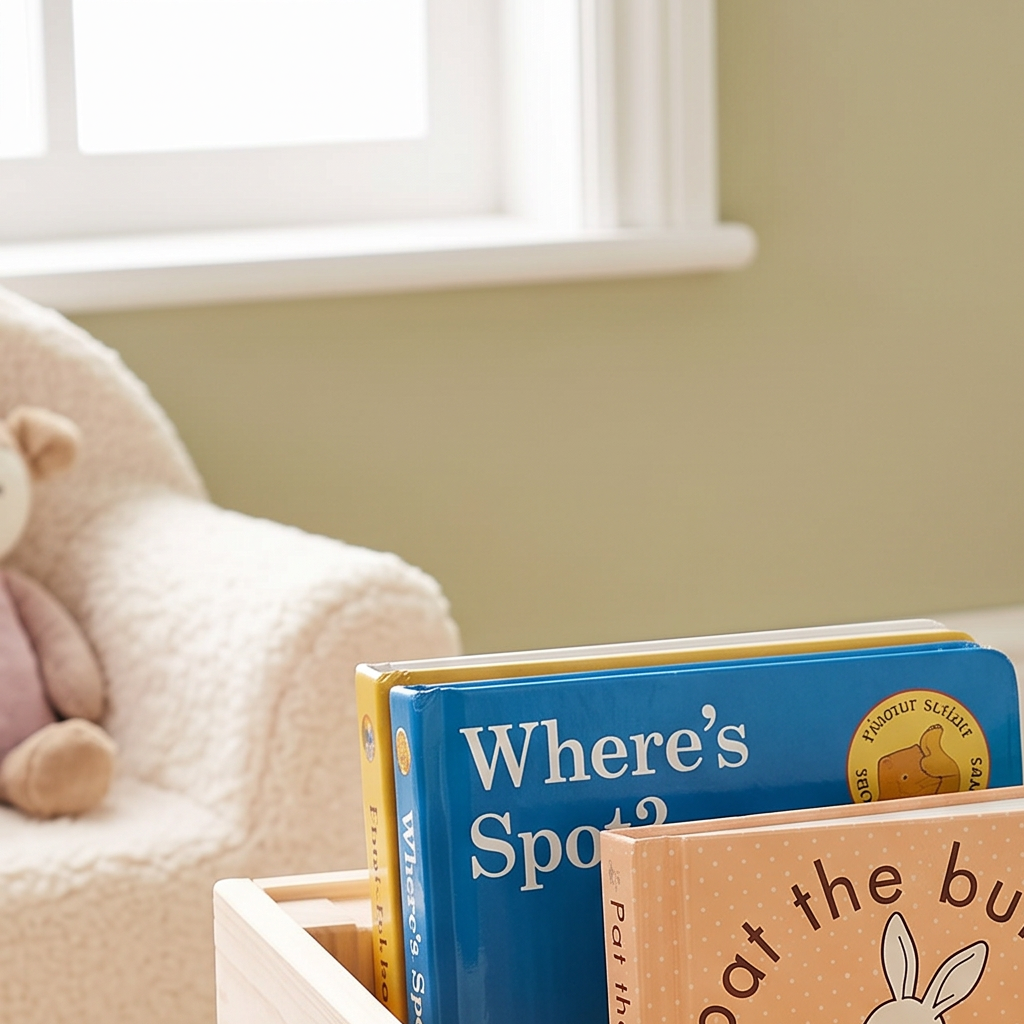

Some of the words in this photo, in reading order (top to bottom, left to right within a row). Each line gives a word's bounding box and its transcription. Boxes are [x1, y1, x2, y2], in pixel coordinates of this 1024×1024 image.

[459, 703, 749, 791] Where's
[401, 810, 423, 958] Where's
[791, 858, 903, 932] the
